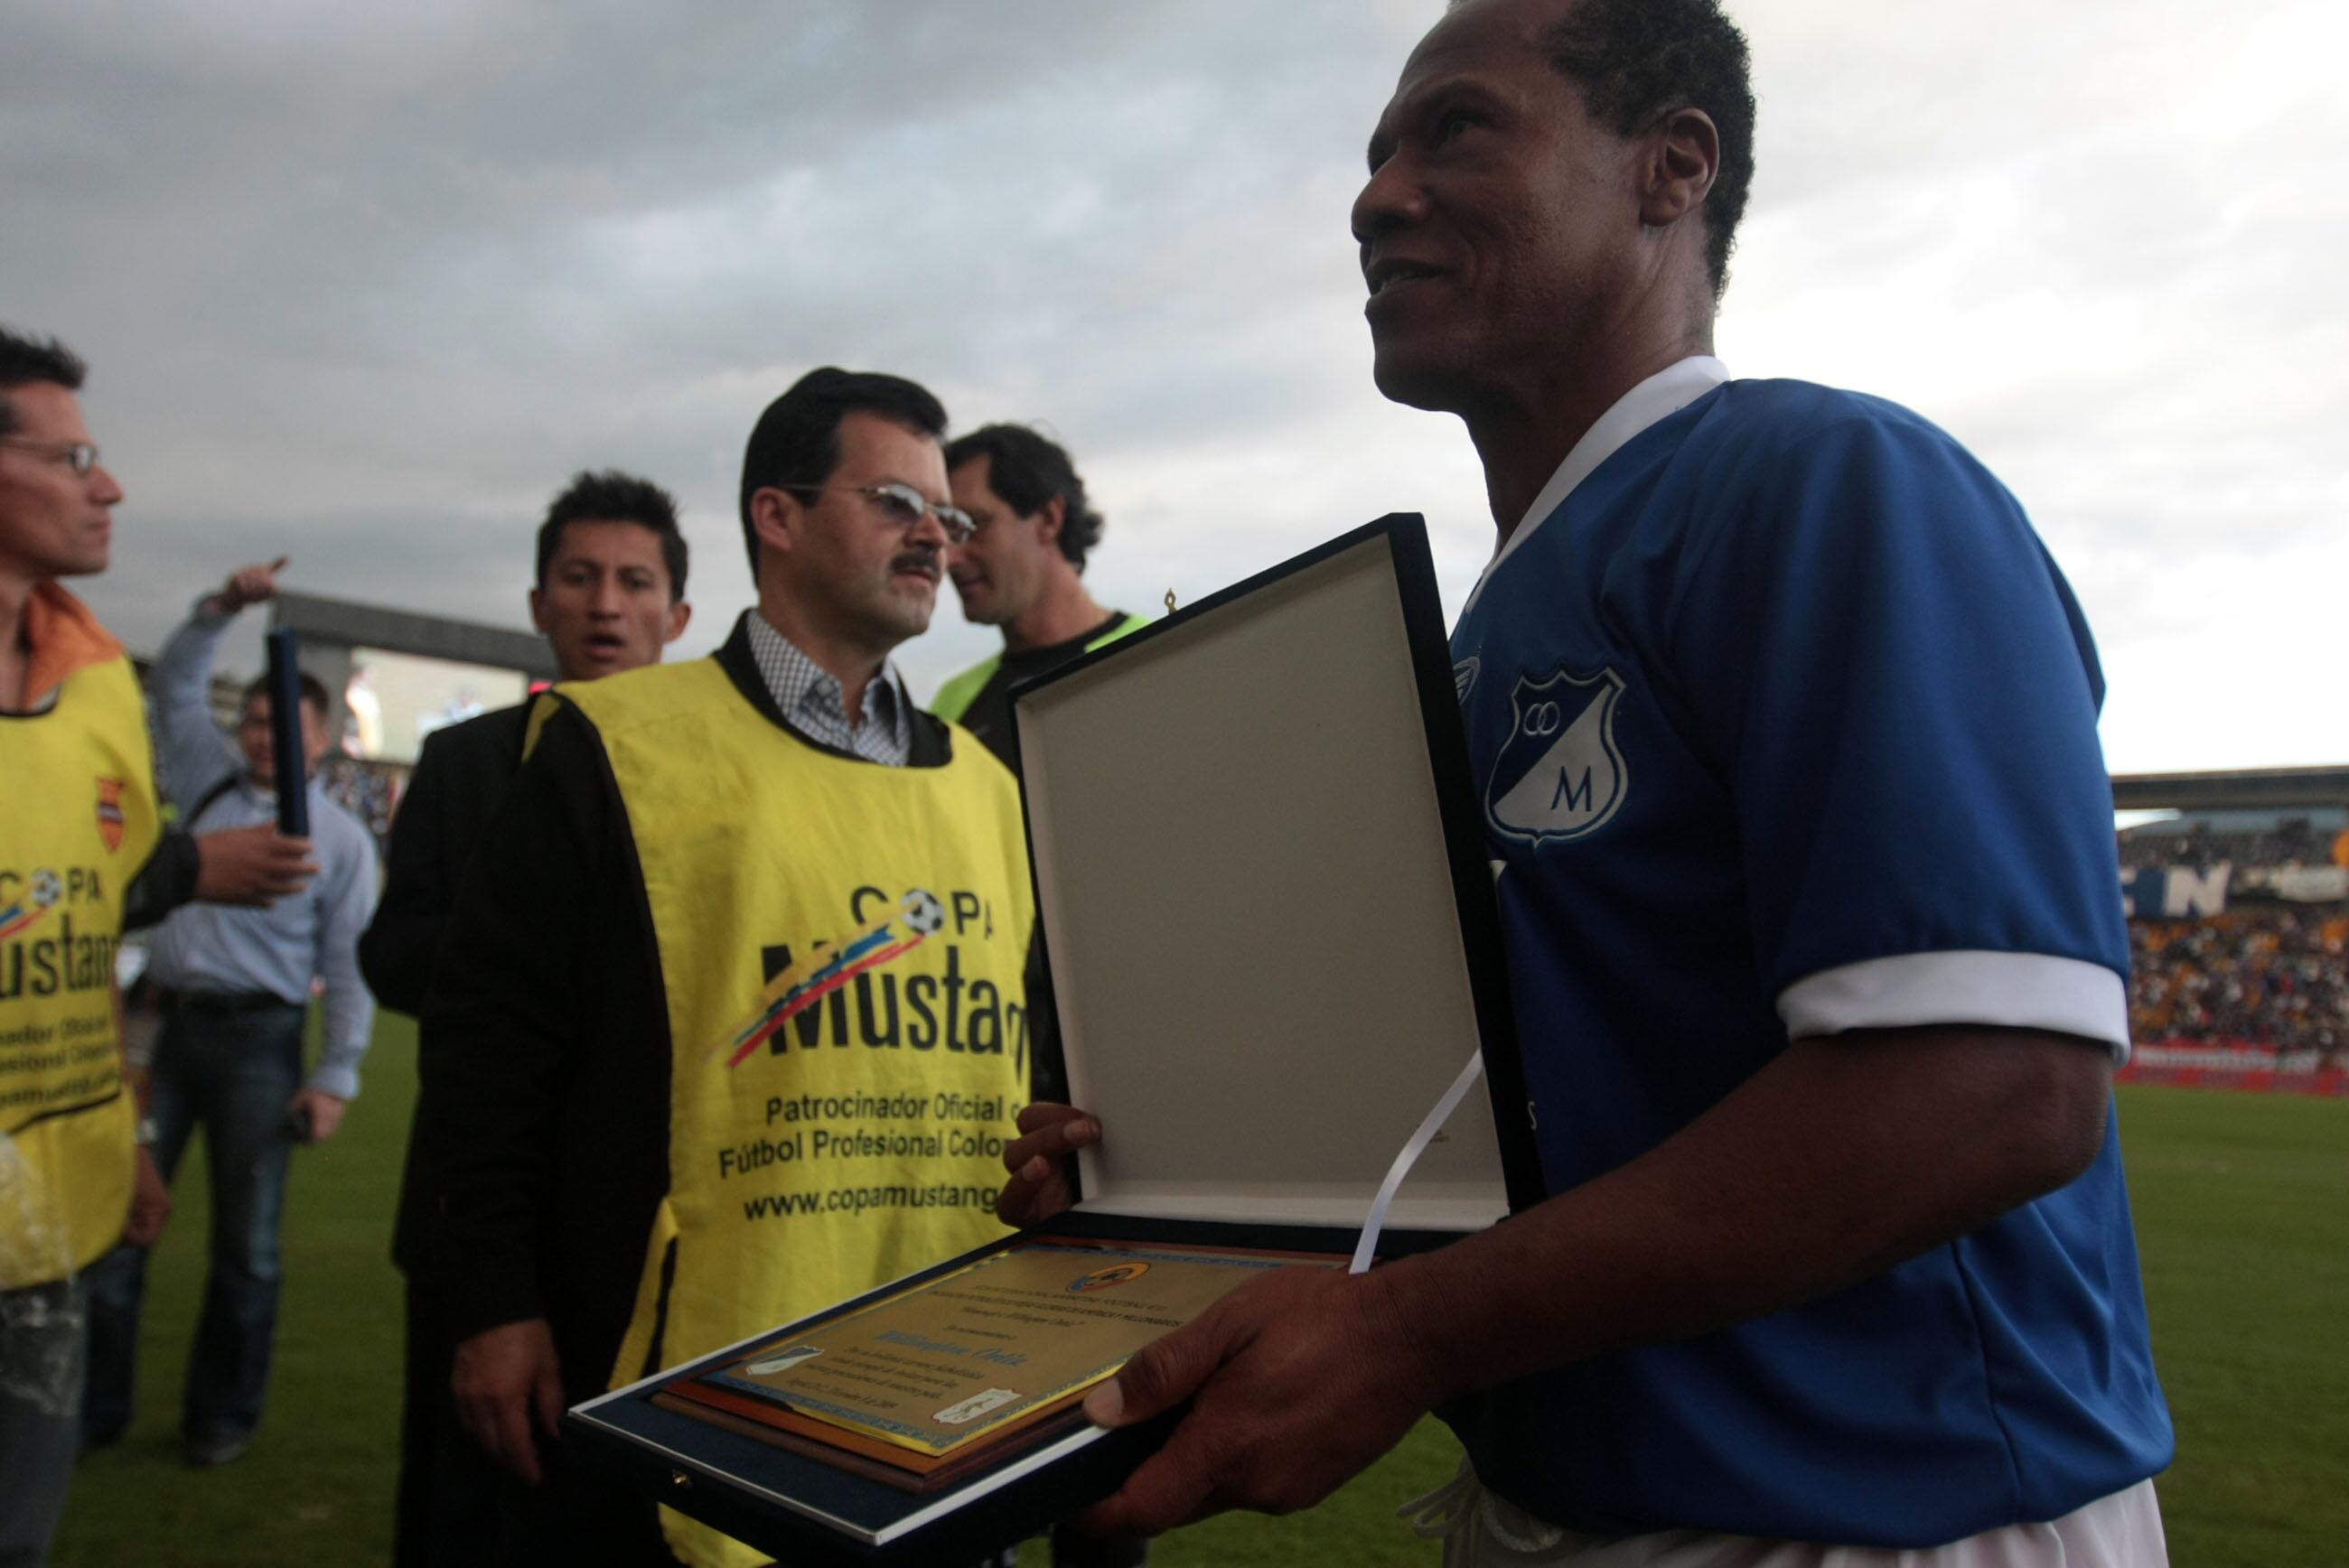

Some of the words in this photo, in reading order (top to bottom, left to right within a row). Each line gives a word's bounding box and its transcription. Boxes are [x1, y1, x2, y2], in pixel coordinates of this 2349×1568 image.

[1551, 766, 1592, 812] M
[766, 1090, 929, 1125] Patrocinador
[934, 1093, 1003, 1122] Oficial
[719, 1132, 803, 1179] Fútbol
[813, 1129, 943, 1159] Profesional
[950, 1130, 1009, 1158] Colo
